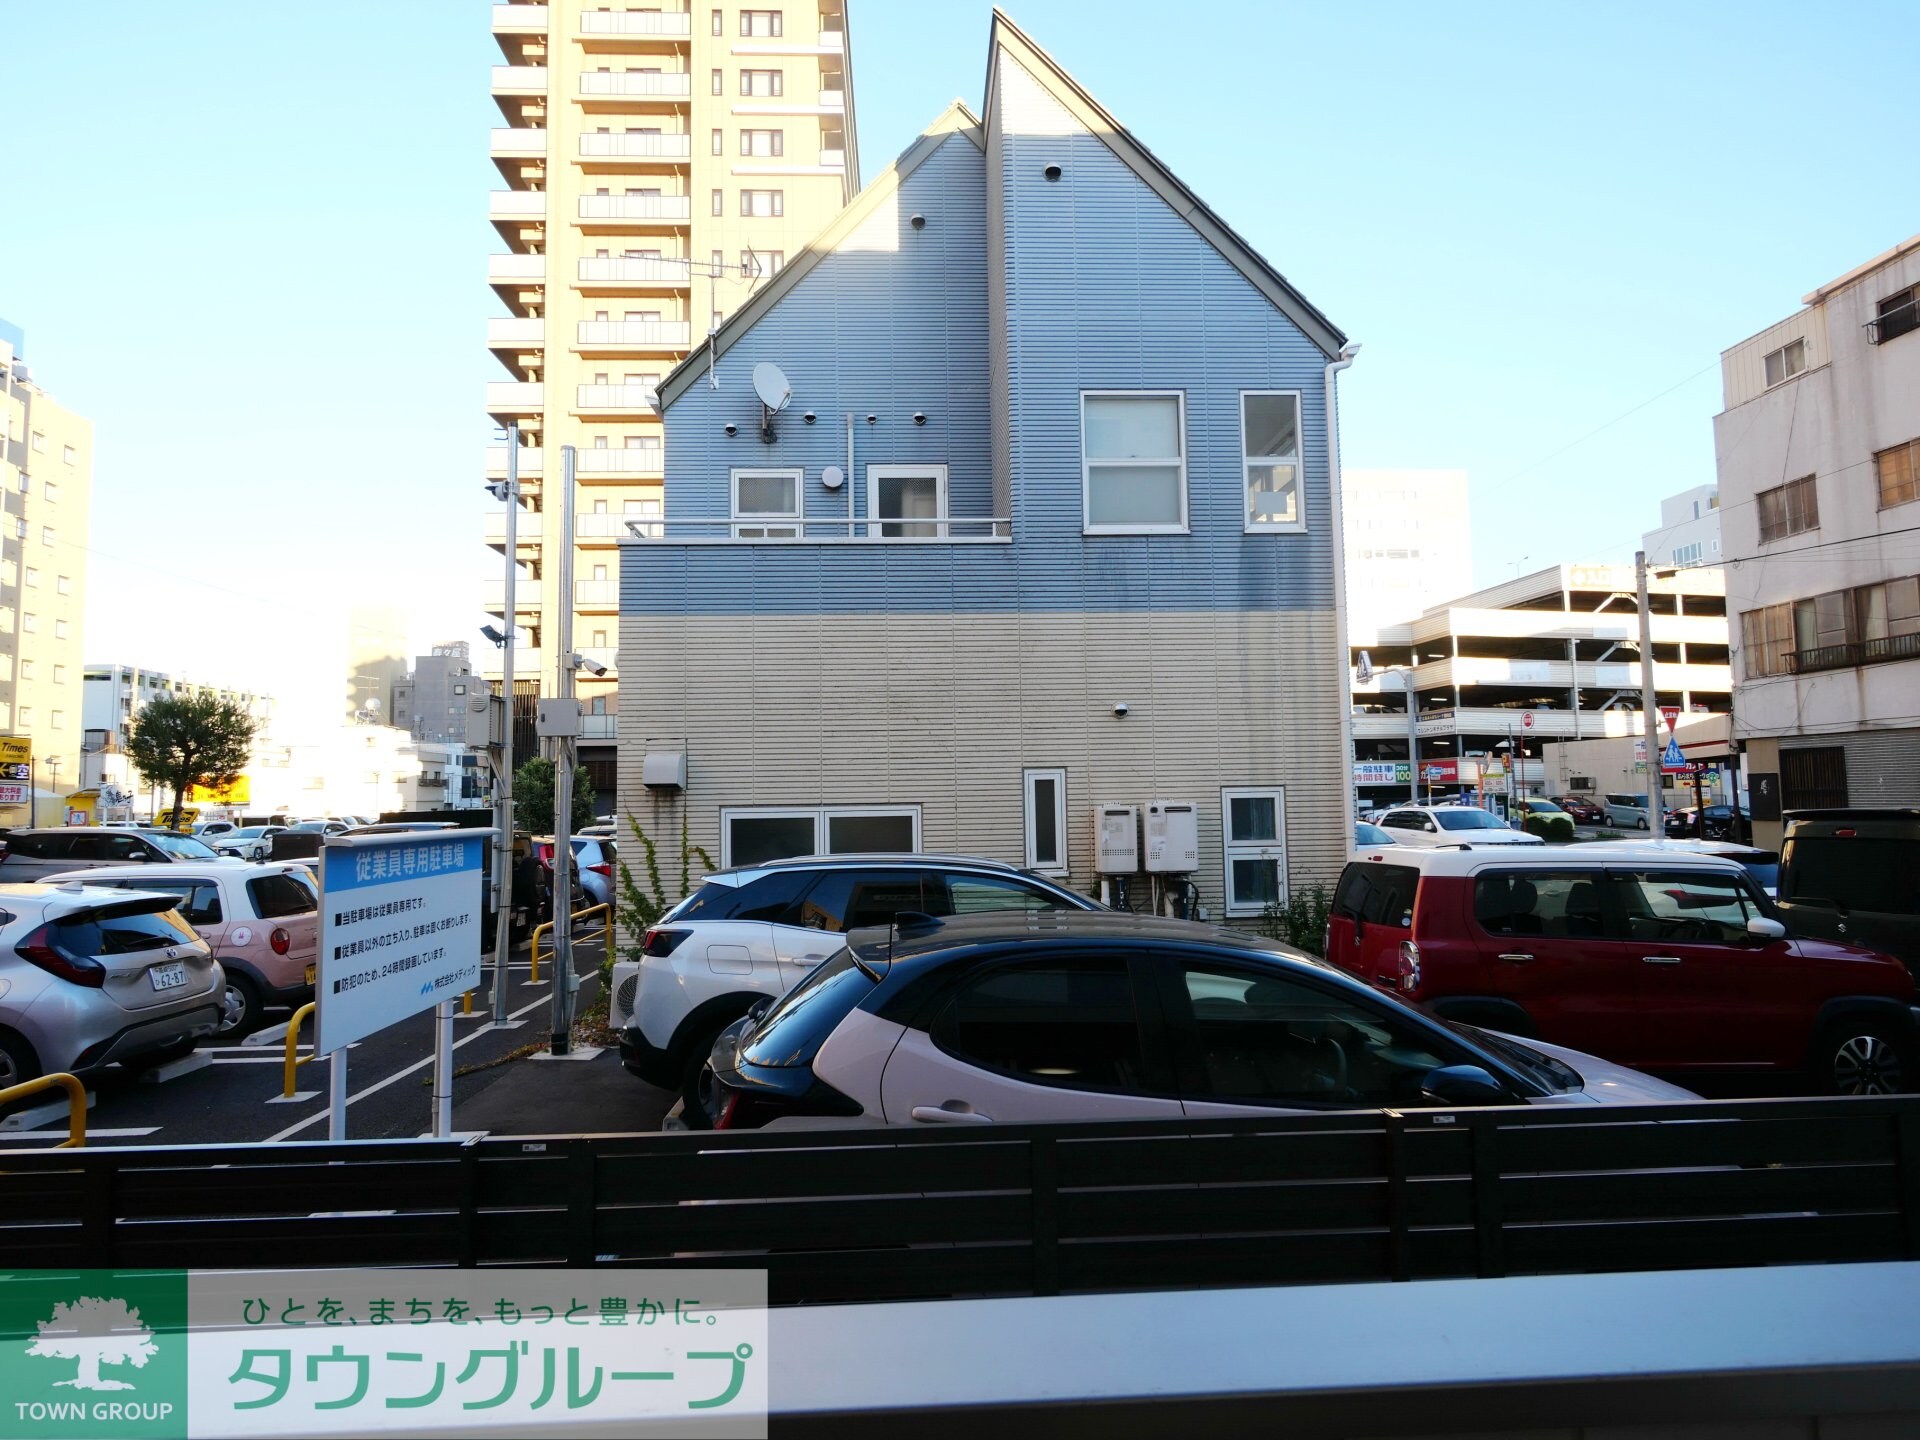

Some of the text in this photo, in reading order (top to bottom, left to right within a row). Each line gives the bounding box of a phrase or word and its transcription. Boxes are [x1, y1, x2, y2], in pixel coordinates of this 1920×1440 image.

[2, 742, 29, 753] Times
[16, 764, 29, 779] 空
[356, 843, 464, 882] 従業員専用駐車場
[343, 897, 426, 925] 当駐車場は従業員専用です。
